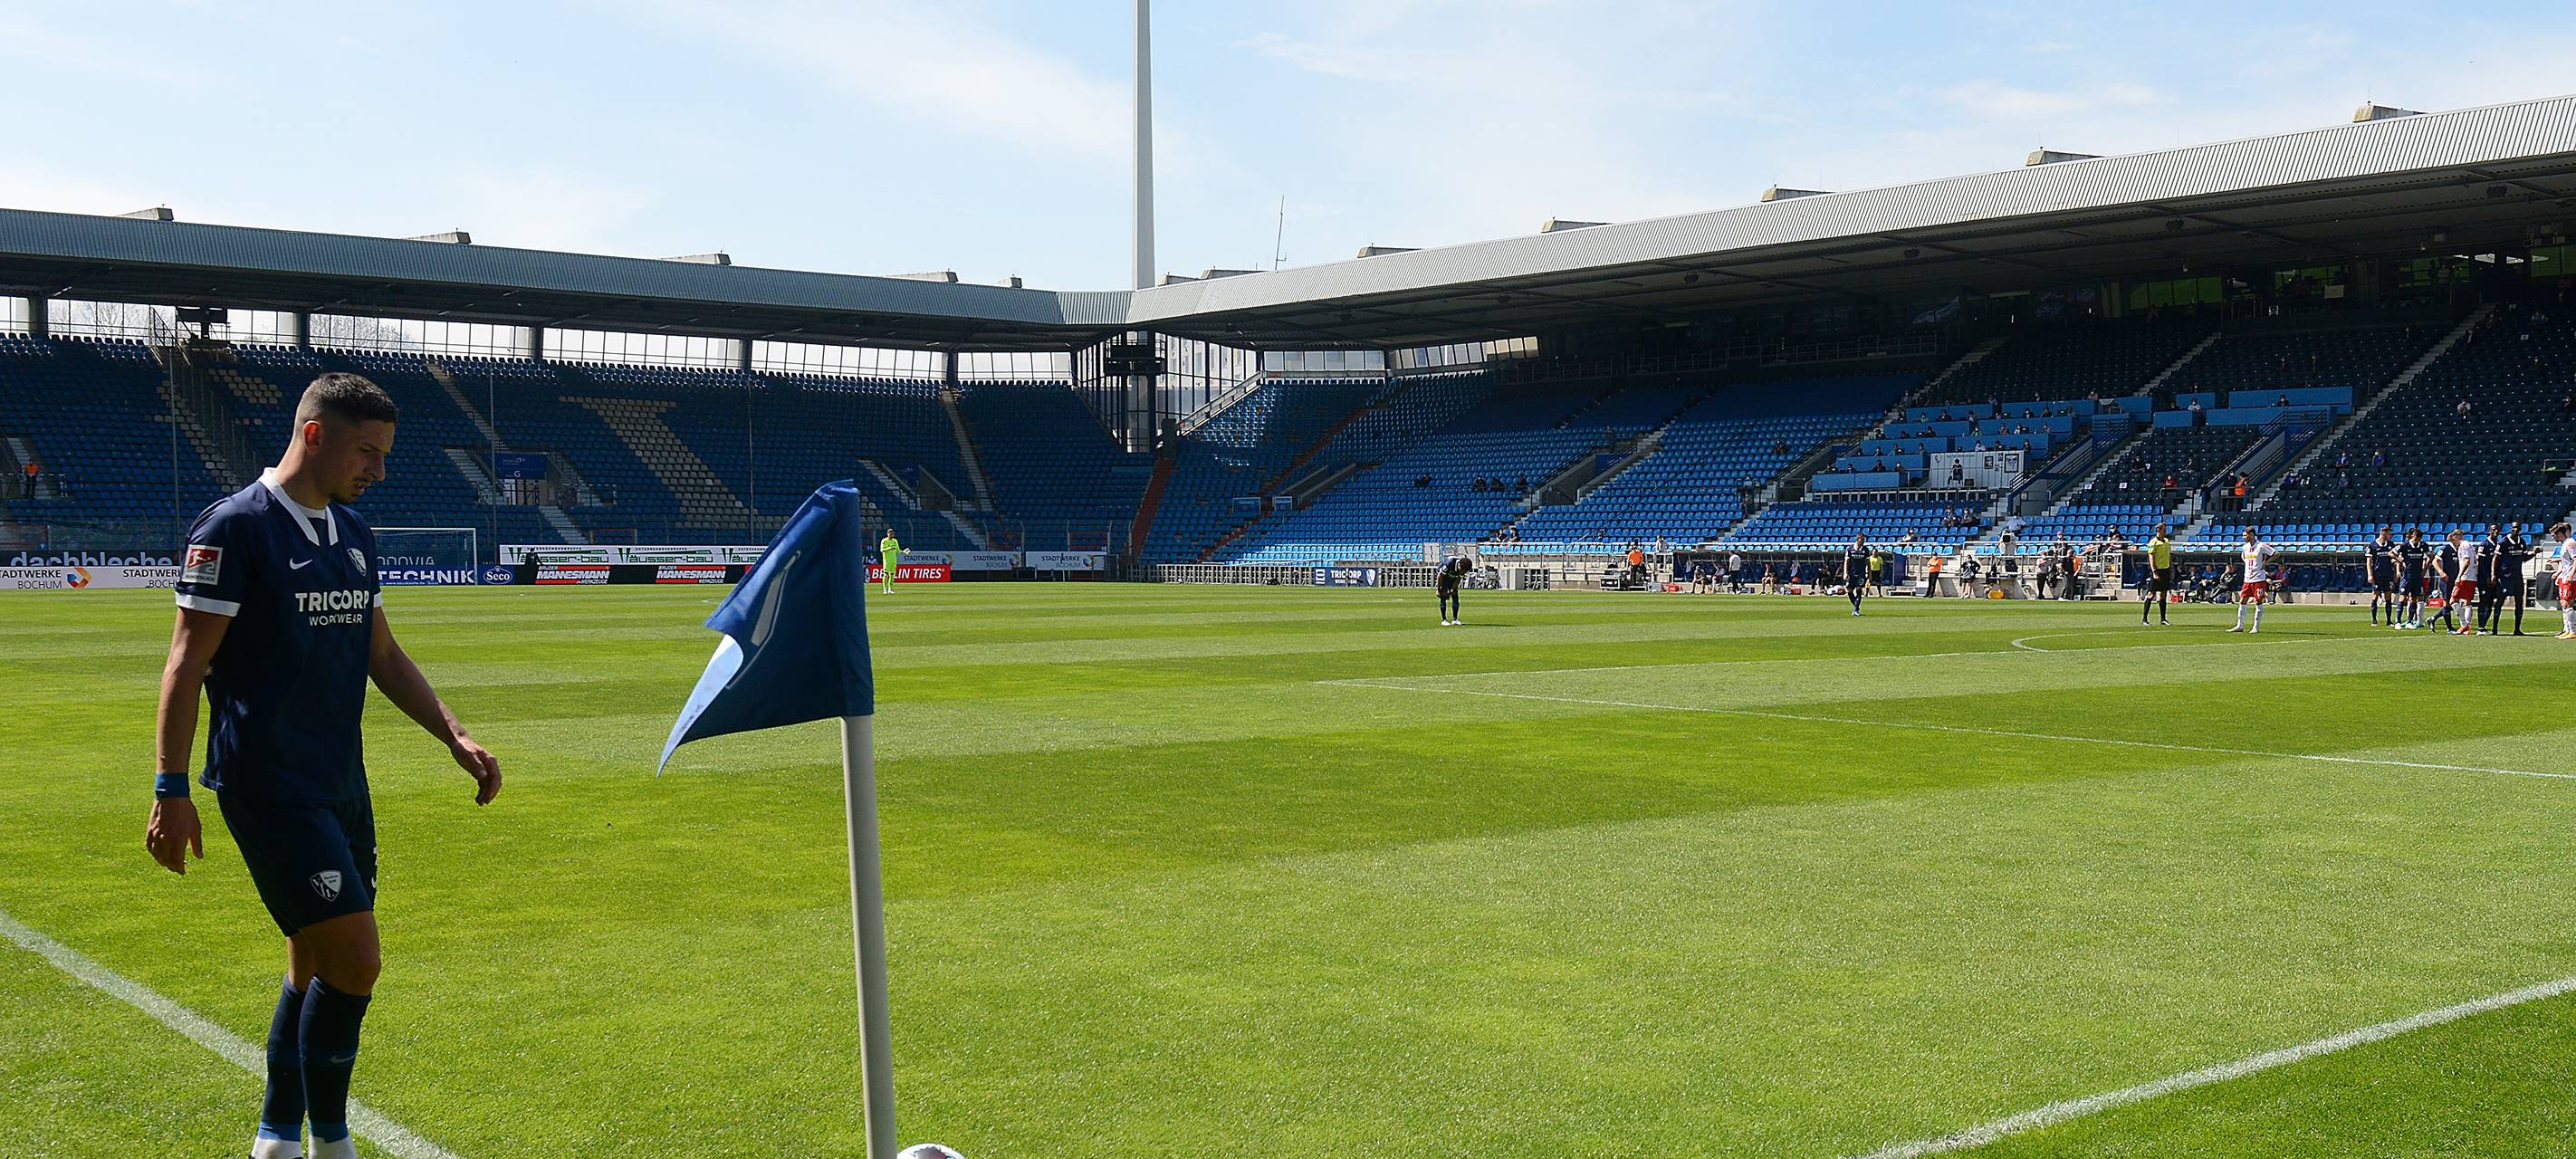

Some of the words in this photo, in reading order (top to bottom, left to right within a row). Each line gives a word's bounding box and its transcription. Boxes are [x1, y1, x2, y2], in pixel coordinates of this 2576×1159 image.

[10, 551, 173, 567] dachbleche
[206, 561, 215, 573] 2
[0, 570, 62, 579] TADTWERKE
[123, 569, 181, 578] STADTWER
[378, 570, 474, 584] TECHNIK
[486, 572, 511, 581] Seco
[872, 569, 911, 579] BELIN
[1330, 570, 1362, 579] TRICORP
[18, 580, 62, 589] BOCHUM
[148, 580, 177, 588] BOCH
[294, 589, 369, 612] TRICORP
